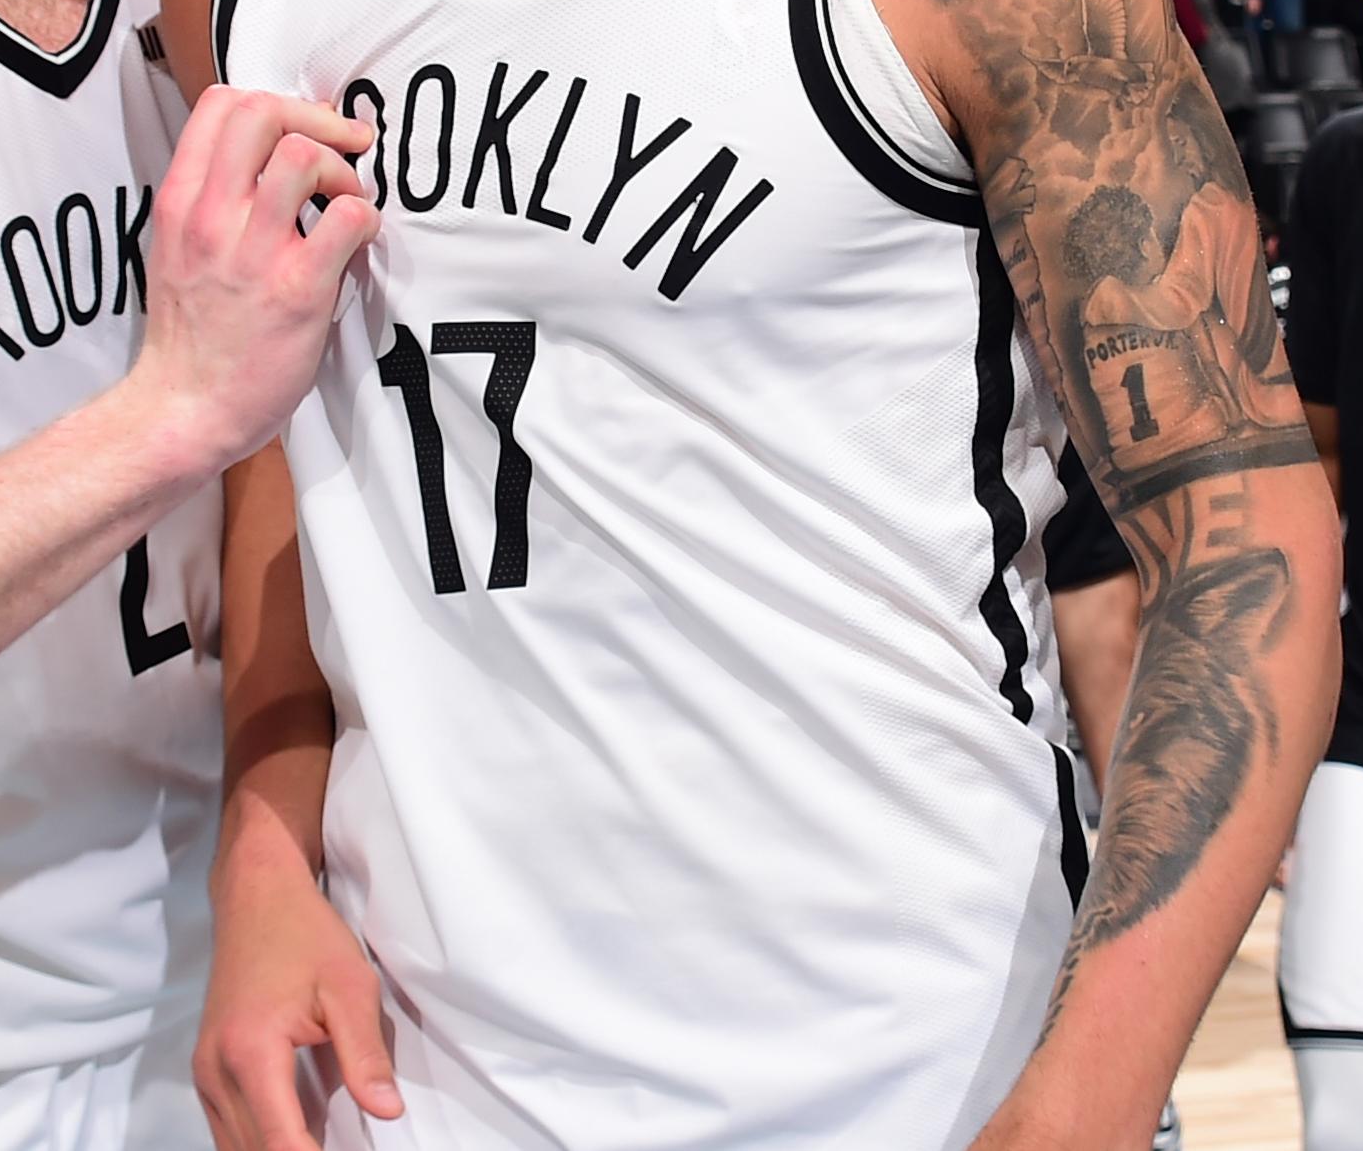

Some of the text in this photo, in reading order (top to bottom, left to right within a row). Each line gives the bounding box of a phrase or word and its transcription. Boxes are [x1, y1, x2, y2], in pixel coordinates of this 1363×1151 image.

[295, 61, 775, 302] OOKLYN
[1086, 332, 1150, 370] PORTER
[1120, 362, 1160, 443] 1
[376, 321, 537, 595] 17
